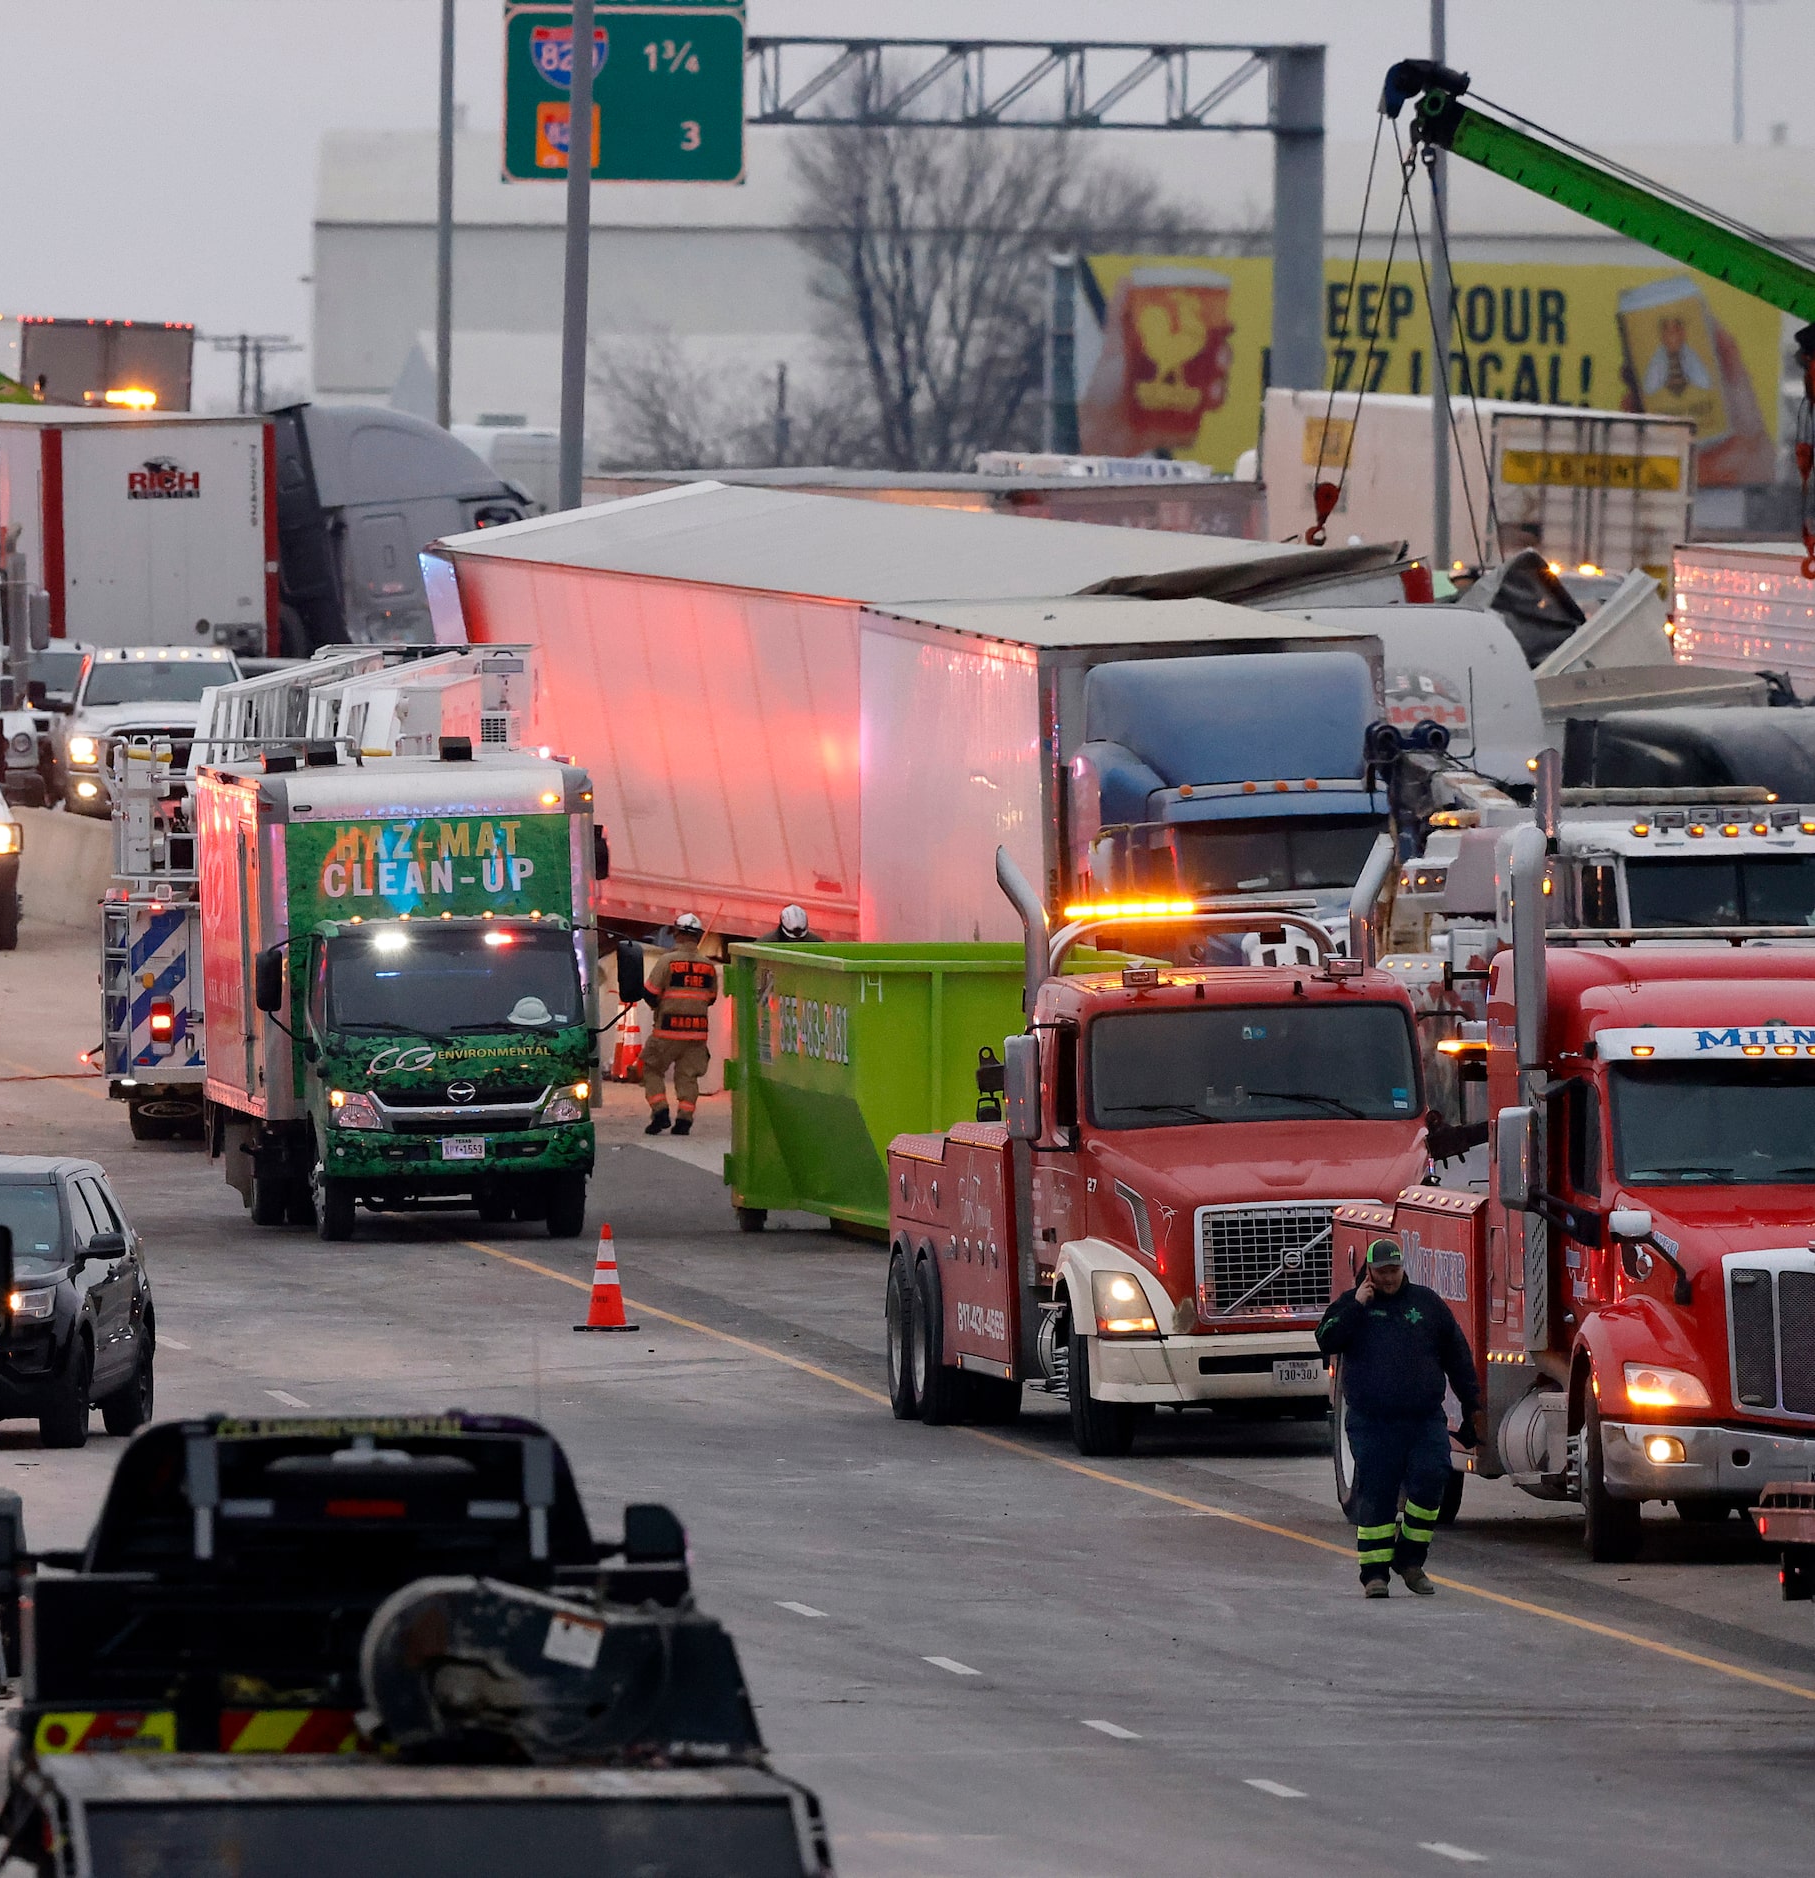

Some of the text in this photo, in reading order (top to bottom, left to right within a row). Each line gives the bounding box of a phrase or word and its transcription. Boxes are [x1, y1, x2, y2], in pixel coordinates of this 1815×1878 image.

[541, 43, 598, 71] 82
[680, 121, 701, 151] 3
[1327, 282, 1414, 340] EEP
[128, 472, 200, 490] RICH
[336, 820, 521, 862] HAZ-MAT
[323, 857, 534, 898] CLEAN-UP
[670, 961, 689, 973] FORT
[685, 975, 704, 987] FIRE
[369, 1046, 551, 1075] CG ENVIRONMENTAL
[1087, 1177, 1098, 1193] 27
